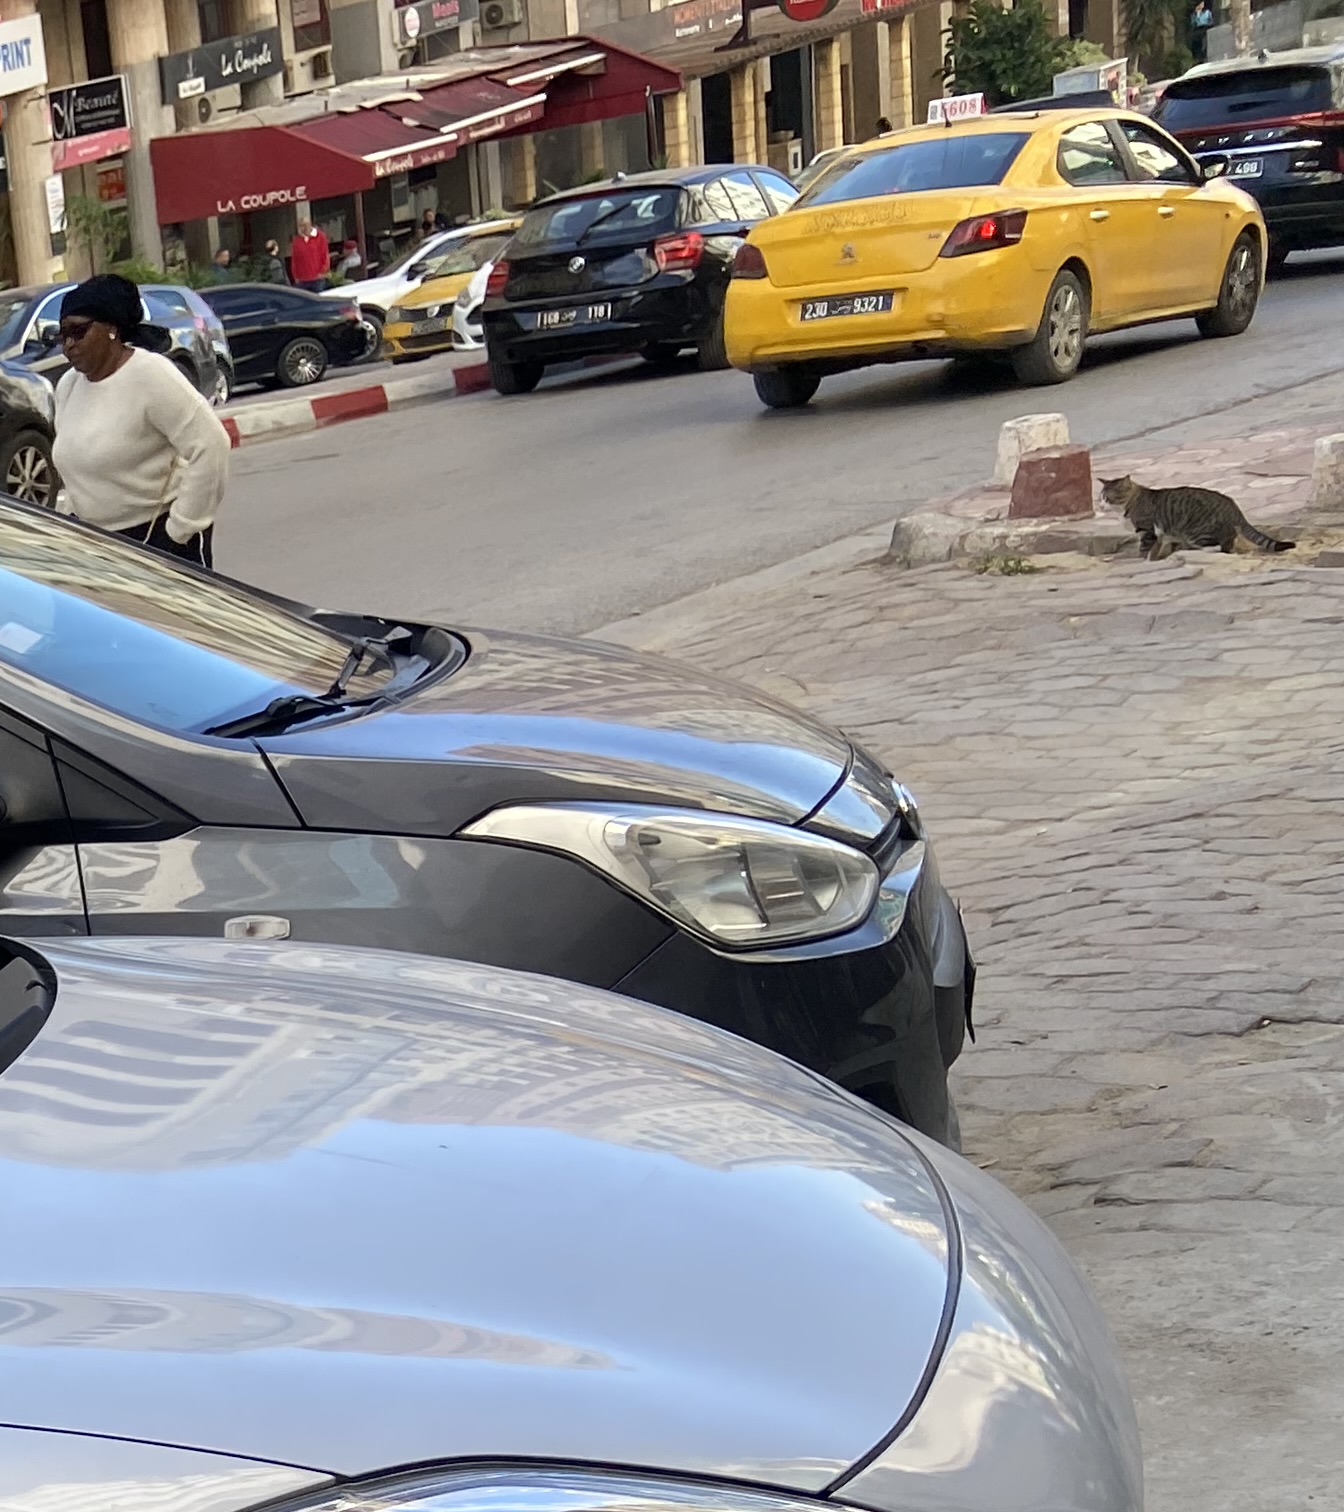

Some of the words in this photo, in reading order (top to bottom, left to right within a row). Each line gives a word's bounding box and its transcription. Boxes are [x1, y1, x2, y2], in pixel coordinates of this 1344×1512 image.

[216, 199, 237, 214] LA
[240, 185, 308, 210] COUPOLE
[805, 302, 829, 320] 230
[853, 296, 883, 314] 9321
